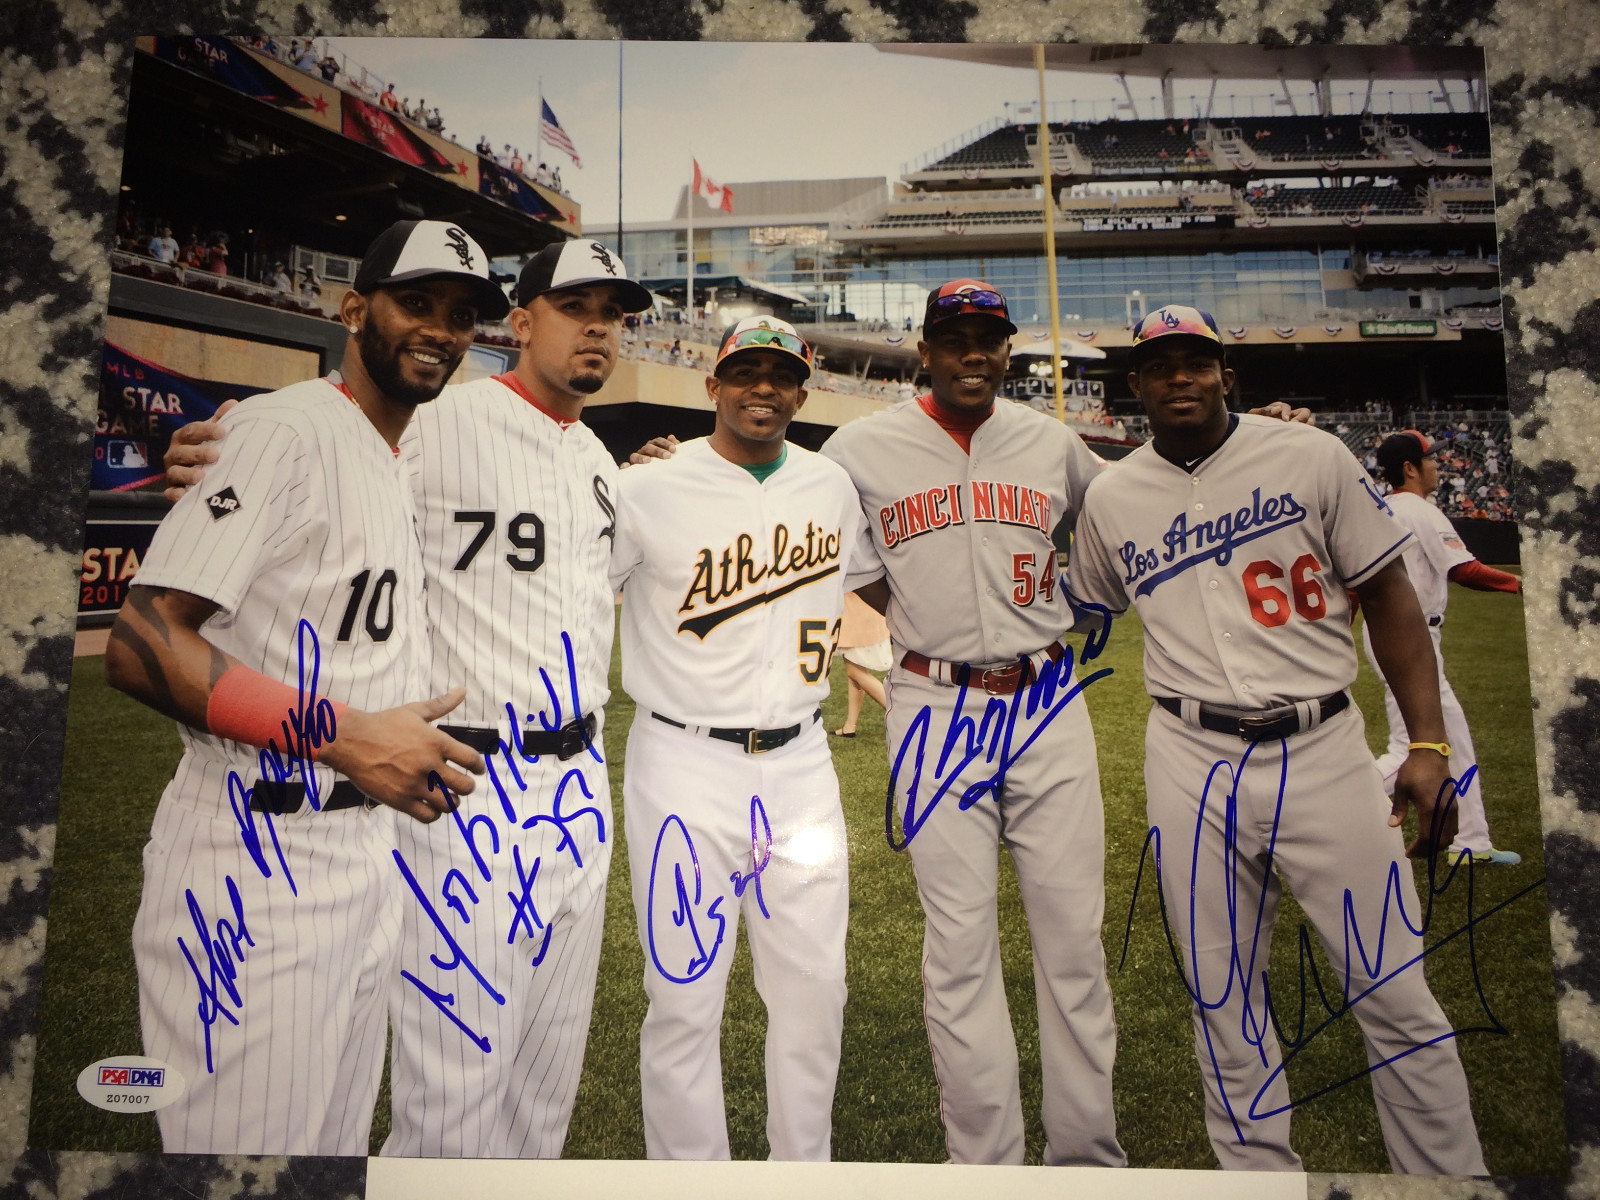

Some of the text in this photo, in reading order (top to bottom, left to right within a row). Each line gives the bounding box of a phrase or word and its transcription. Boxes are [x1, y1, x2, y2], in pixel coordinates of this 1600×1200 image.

[194, 37, 229, 64] STAR
[106, 361, 145, 380] MLB
[122, 386, 184, 415] STAR
[96, 409, 161, 436] GAME
[209, 495, 237, 511] DJR
[453, 510, 546, 573] 79
[1119, 487, 1307, 586] Los Angeles
[80, 547, 144, 583] STA
[1012, 549, 1056, 608] 54
[82, 586, 121, 605] 201
[1241, 553, 1327, 628] 66
[336, 568, 397, 643] 10
[102, 1069, 161, 1085] PSA DNA
[106, 1094, 150, 1104] Z07007
